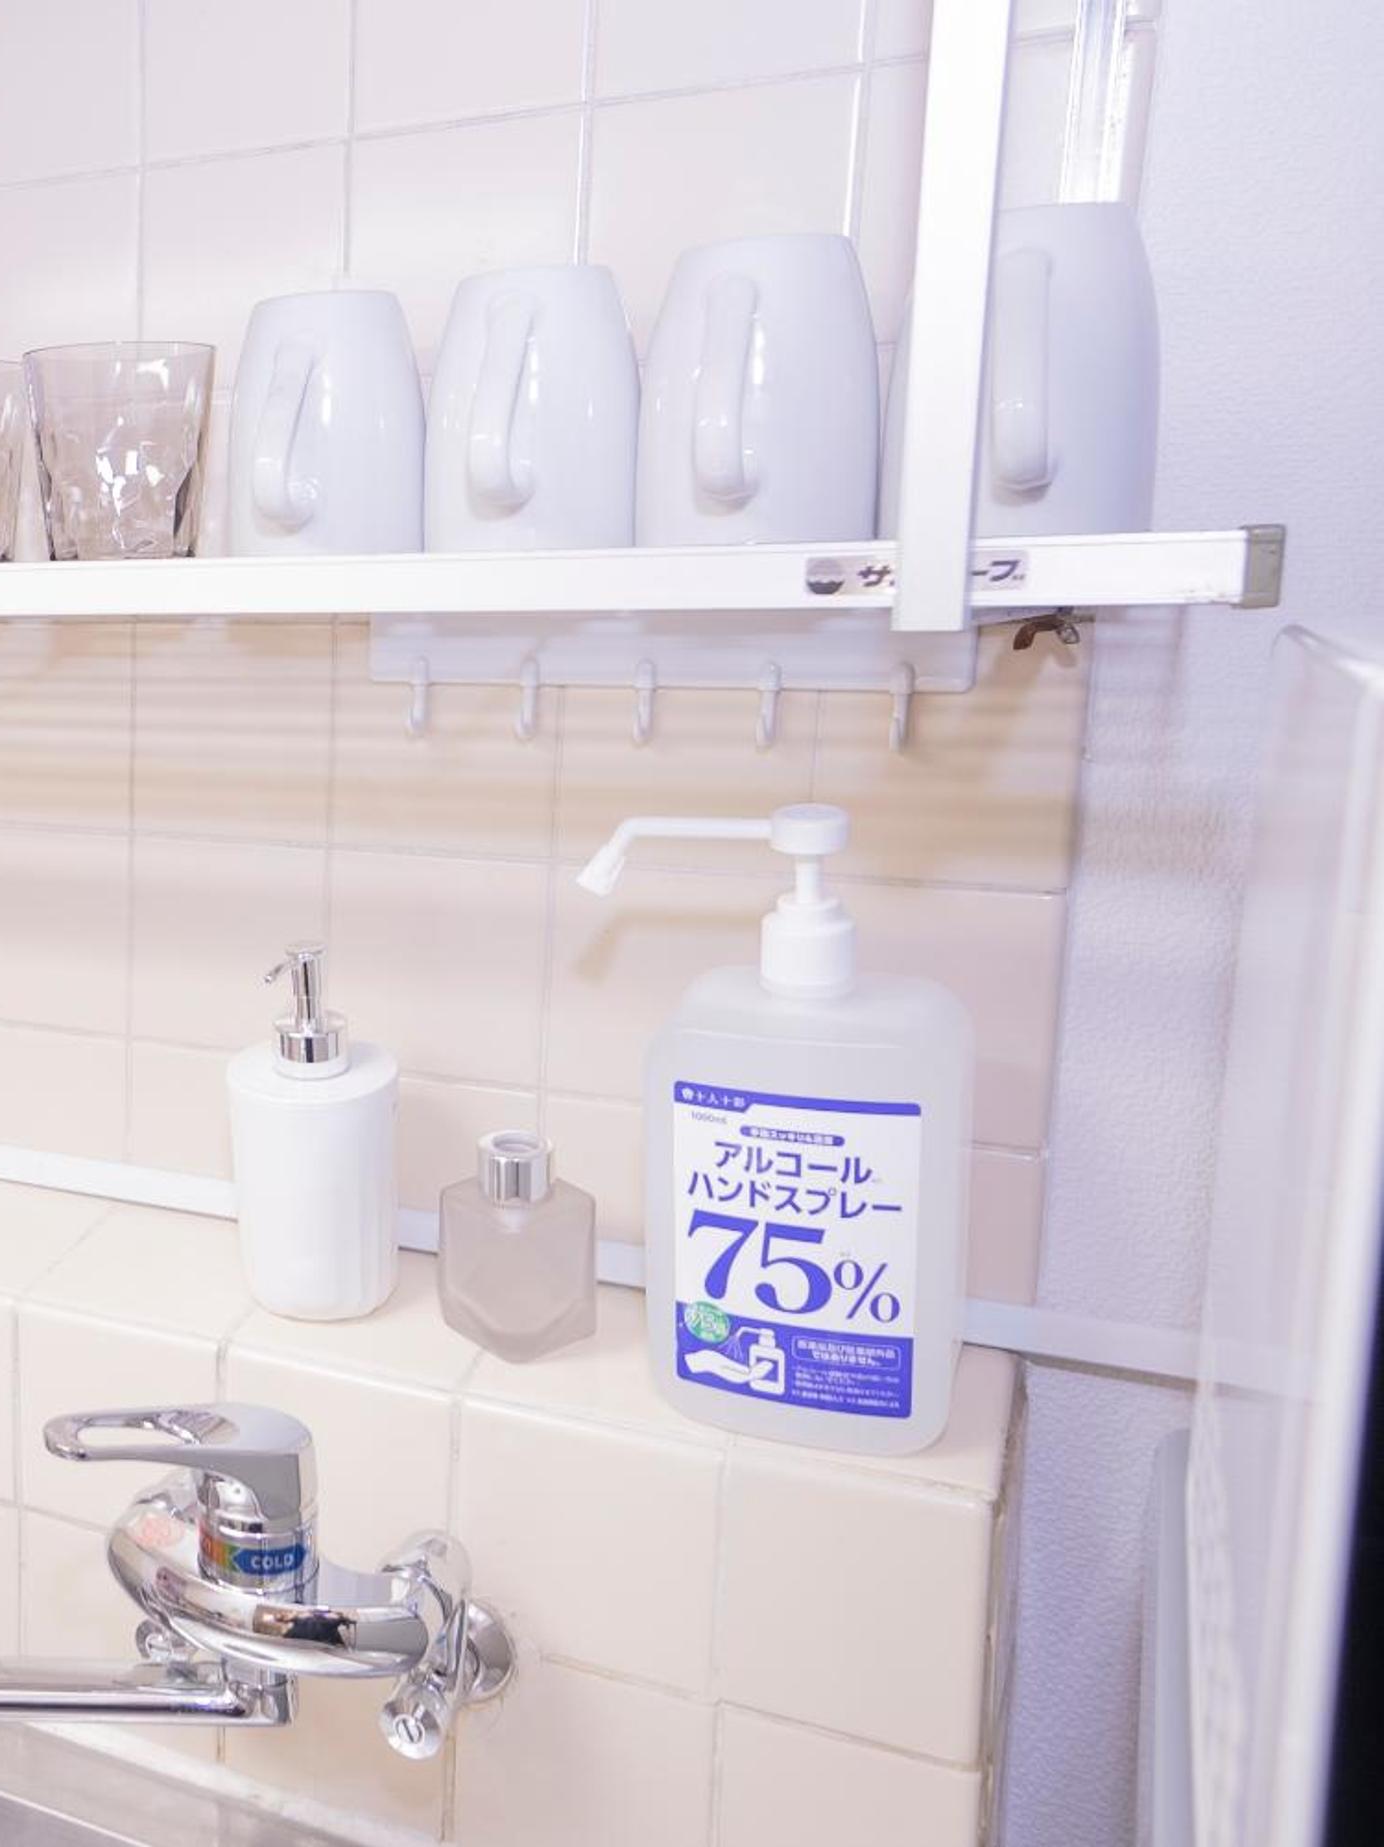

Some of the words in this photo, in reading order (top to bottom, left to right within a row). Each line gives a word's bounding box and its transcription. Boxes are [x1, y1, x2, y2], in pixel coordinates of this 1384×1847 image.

[714, 1141, 873, 1185] アルコール
[687, 1171, 902, 1219] ハンドスプレー
[687, 1208, 901, 1323] 75%
[250, 1553, 295, 1570] COLD
